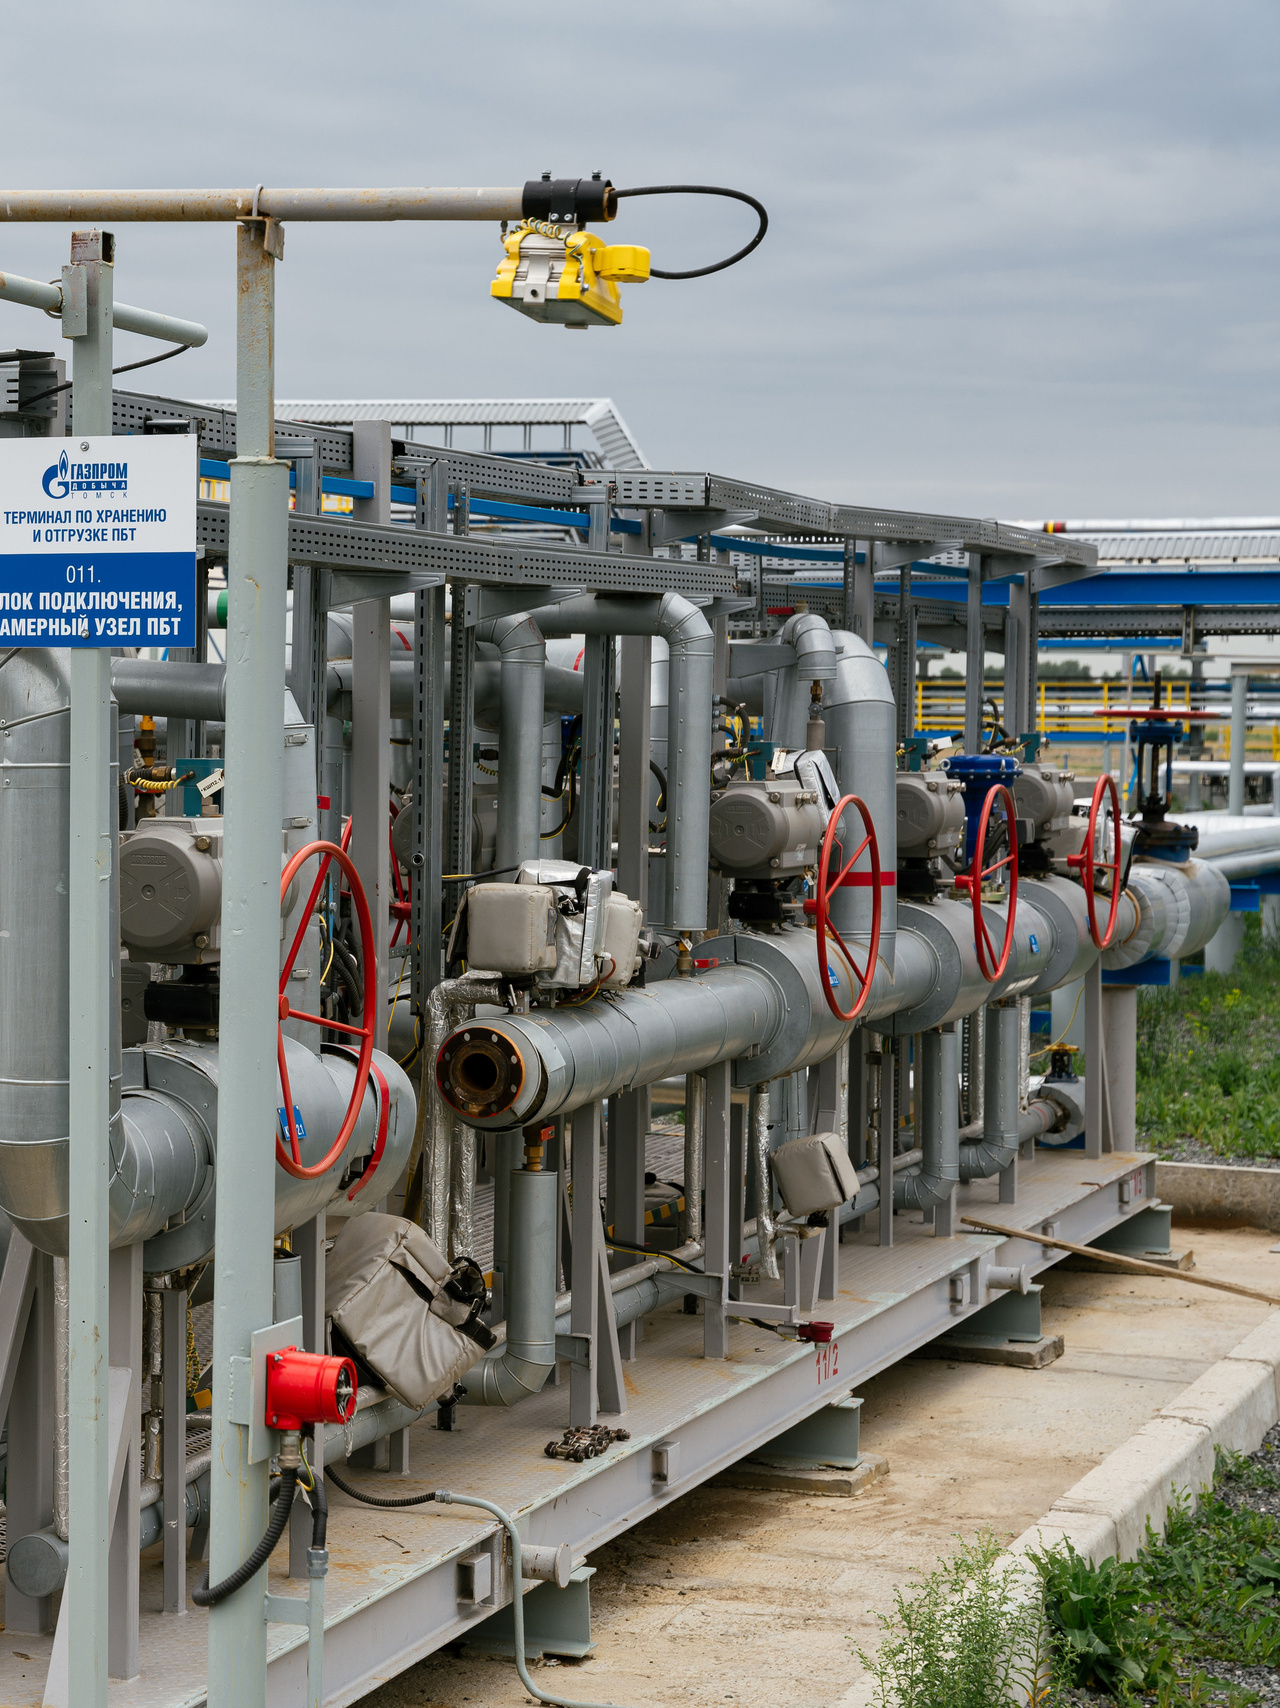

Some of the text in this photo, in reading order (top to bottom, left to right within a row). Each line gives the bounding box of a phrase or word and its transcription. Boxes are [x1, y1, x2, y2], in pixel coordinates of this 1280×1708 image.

[71, 463, 127, 480] ГАЗПРОМ
[72, 482, 126, 490] ДОБЫЧА
[71, 491, 128, 499] ТОМСК
[4, 508, 167, 525] ТЕРМИНАЛ ПО ХРАНЕНИЮ
[33, 528, 137, 544] И ОТГРУЗКЕ ПБТ
[66, 565, 101, 583] 011.
[39, 591, 183, 613] ПОДКЛЮЧЕНИЯ,
[95, 617, 141, 636] УЗЕЛ
[147, 617, 181, 636] ПБТ
[816, 1343, 839, 1385] 11/2
